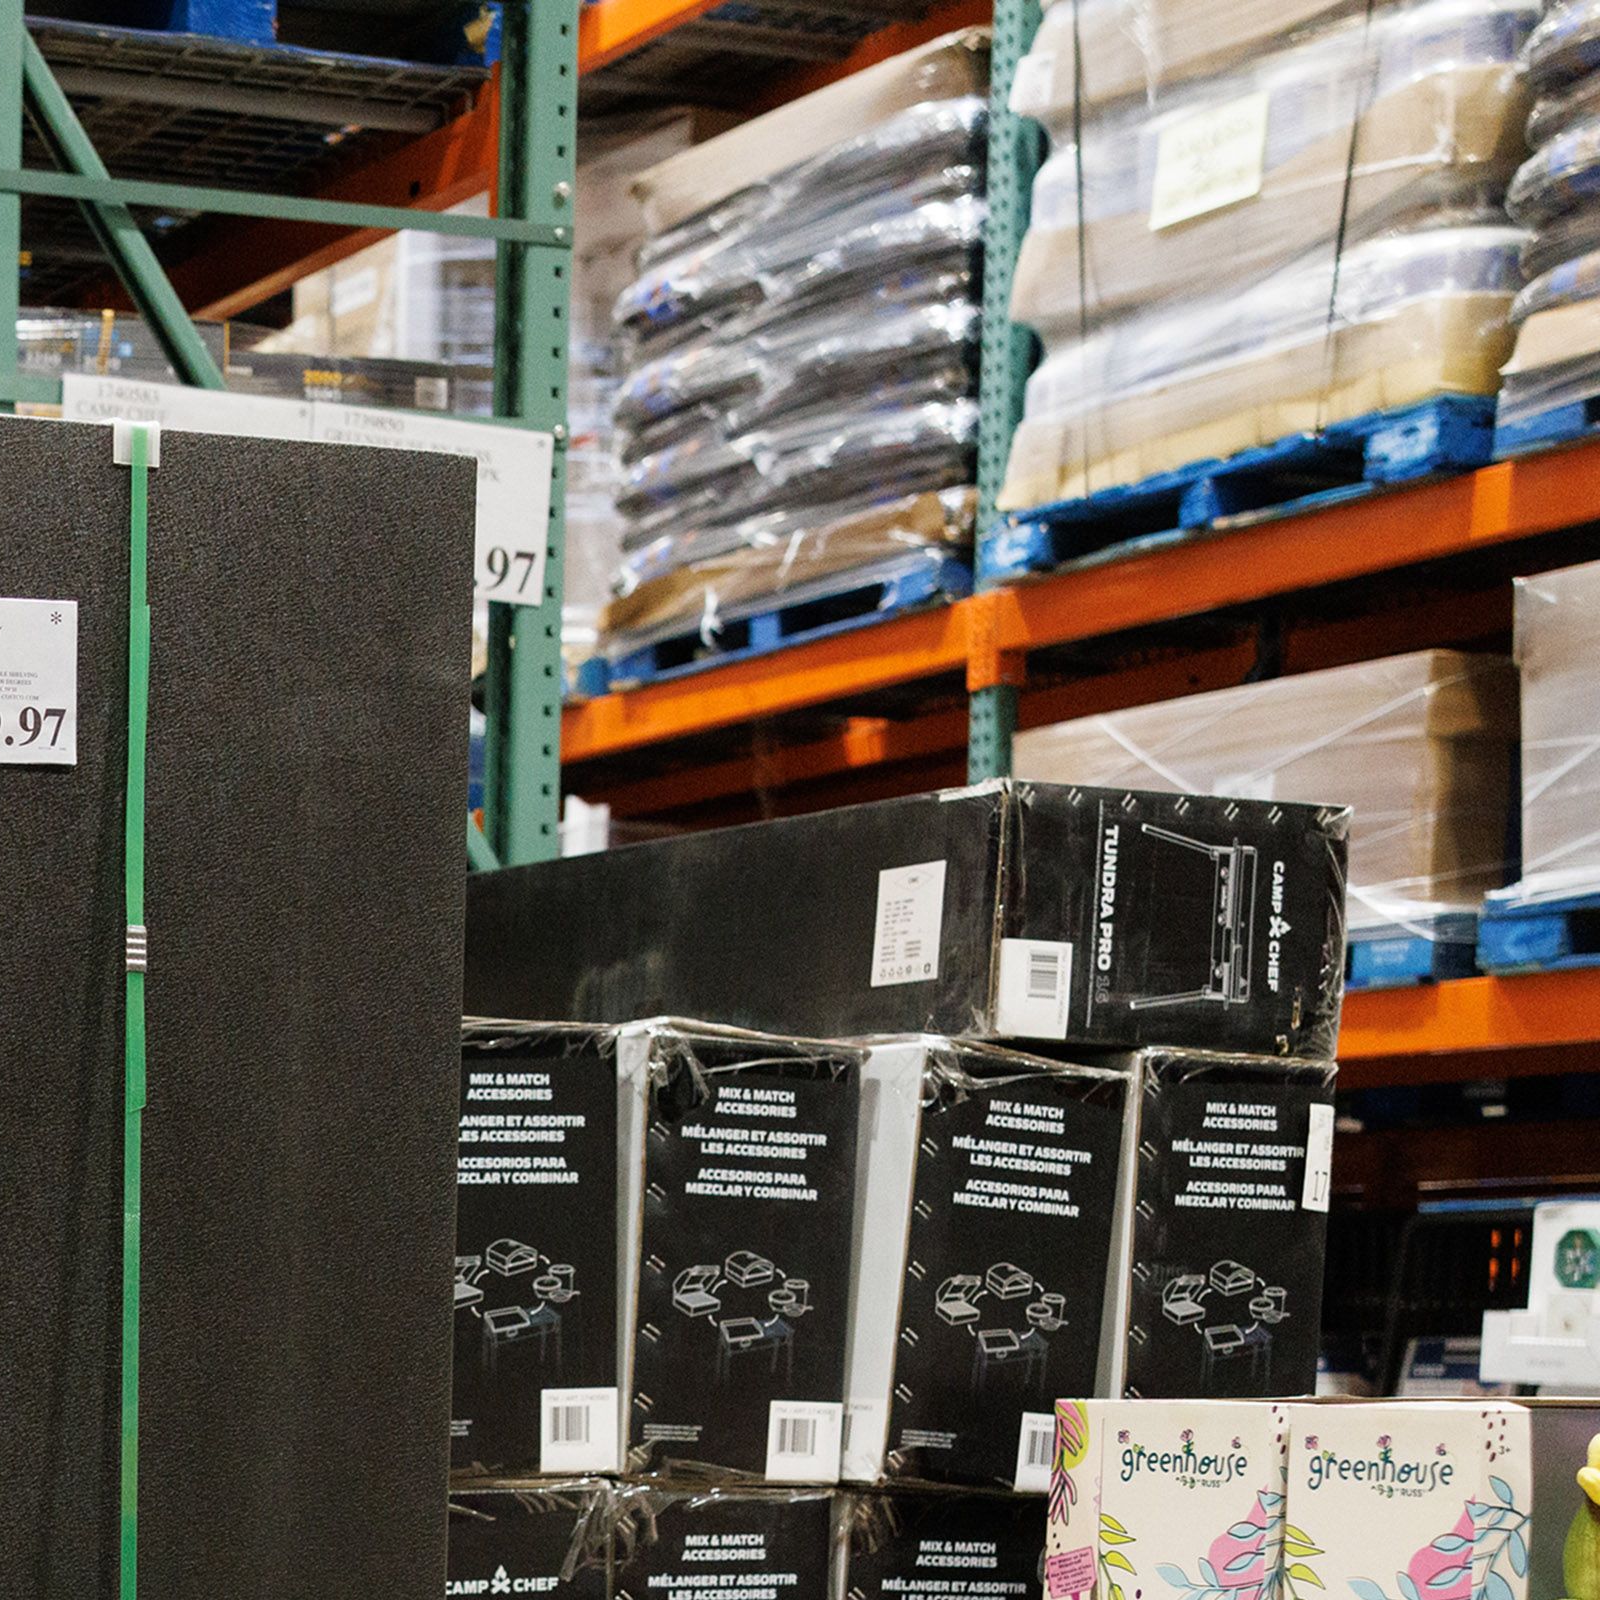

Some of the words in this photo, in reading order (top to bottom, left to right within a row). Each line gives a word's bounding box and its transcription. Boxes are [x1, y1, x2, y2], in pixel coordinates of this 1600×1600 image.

[1100, 824, 1119, 921] TUNDRA
[1268, 860, 1285, 914] CAMP
[1097, 922, 1114, 972] PRO
[1266, 940, 1280, 993] CHEF
[718, 1086, 742, 1100] MIX
[742, 1088, 752, 1101] &
[753, 1088, 795, 1103] MATCH
[714, 1101, 797, 1119] ACCESSORIES
[989, 1101, 1012, 1113] MIX
[1012, 1103, 1022, 1114] &
[1023, 1105, 1064, 1119] MATCH
[1205, 1102, 1228, 1115] MIX
[1228, 1103, 1238, 1115] &
[1239, 1103, 1276, 1117] MATCH
[985, 1115, 1065, 1133] ACCESSORIES
[1202, 1115, 1278, 1132] ACCESSORIES
[681, 1124, 749, 1143] MÉLANGER
[751, 1129, 766, 1143] ET
[767, 1130, 827, 1146] ASSORTIR
[700, 1141, 724, 1155] LES
[725, 1142, 807, 1160] ACCESSOIRES
[951, 1135, 1018, 1154] MÉLANGER
[1018, 1144, 1033, 1157] ET
[1033, 1148, 1092, 1163] ASSORTIR
[1171, 1139, 1234, 1155] MÉLANGER
[1235, 1142, 1248, 1156] ET
[1249, 1144, 1305, 1158] ASSORTIR
[969, 1154, 993, 1167] LES
[994, 1157, 1072, 1175] ACCESSOIRES
[1189, 1155, 1210, 1168] LES
[1211, 1156, 1286, 1172] ACCESSOIRES
[697, 1168, 772, 1184] ACCESORIOS
[773, 1171, 806, 1186] PARA
[685, 1181, 743, 1198] MEZCLAR
[743, 1184, 752, 1197] Y
[753, 1185, 817, 1201] COMBINAR
[965, 1180, 1036, 1197] ACCESORIOS
[1037, 1187, 1070, 1201] PARA
[1185, 1180, 1254, 1195] ACCESORIOS
[1254, 1182, 1286, 1197] PARA
[952, 1193, 1008, 1208] MEZCLAR
[1009, 1199, 1018, 1210] Y
[1018, 1200, 1080, 1217] COMBINAR
[1174, 1194, 1228, 1209] MEZCLAR
[1228, 1196, 1238, 1209] Y
[1238, 1197, 1296, 1212] COMBINAR
[1120, 1447, 1248, 1483] greenhouse
[1308, 1451, 1453, 1491] greenhouse
[512, 1577, 559, 1592] CHEF
